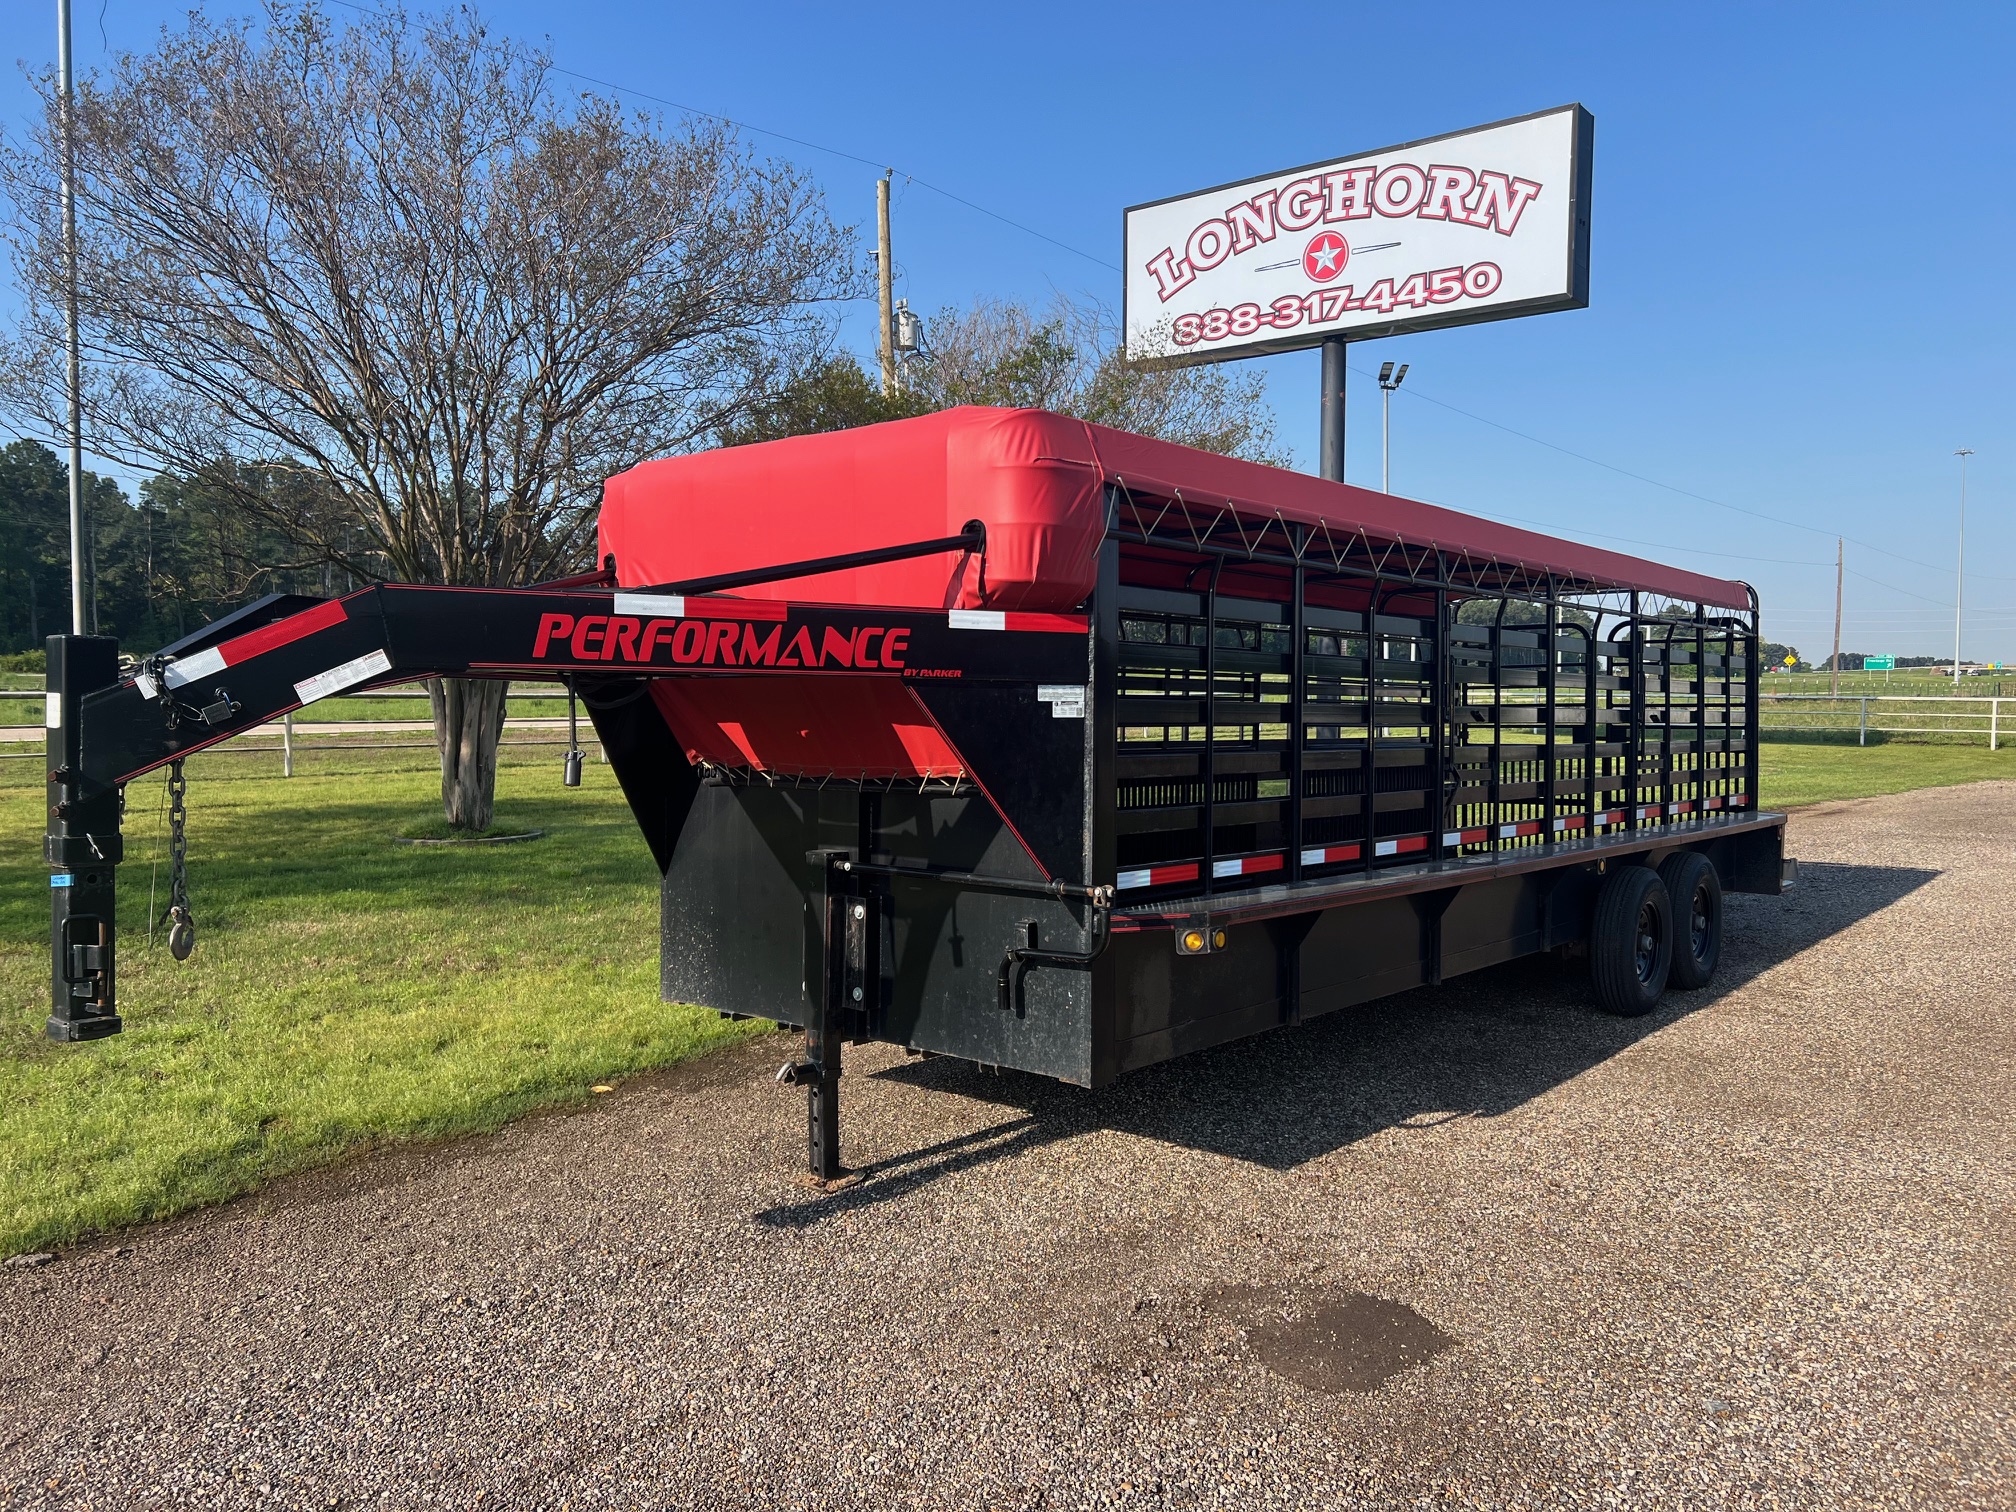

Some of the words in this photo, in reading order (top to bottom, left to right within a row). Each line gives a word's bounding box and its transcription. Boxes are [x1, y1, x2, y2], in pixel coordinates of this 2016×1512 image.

[1147, 163, 1543, 303] LONGHORN
[1172, 261, 1502, 346] 888-317-4450
[532, 612, 911, 669] PERFORMANCE
[903, 668, 919, 677] BY
[920, 669, 962, 678] PARKER
